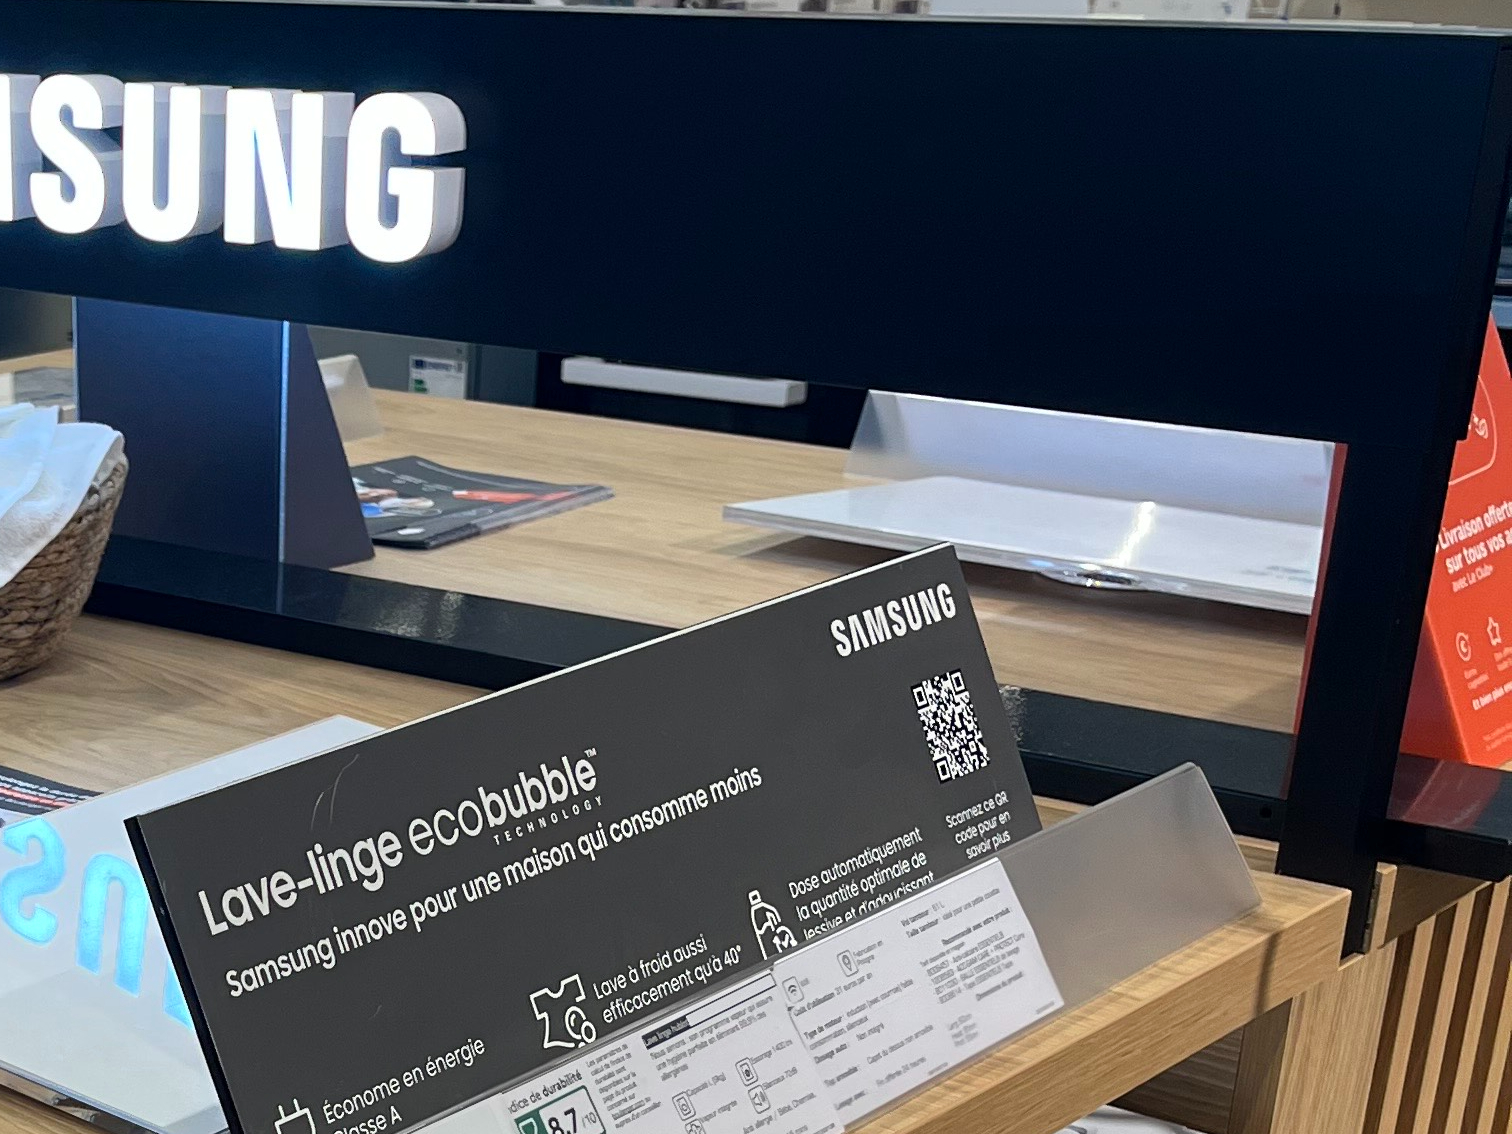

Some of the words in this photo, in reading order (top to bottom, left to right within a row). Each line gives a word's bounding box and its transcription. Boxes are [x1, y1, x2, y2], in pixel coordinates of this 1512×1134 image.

[1445, 552, 1463, 575] sur
[1462, 541, 1488, 566] tous
[830, 582, 957, 657] SAMSUNG
[493, 795, 603, 846] TECHNOLOGY
[945, 803, 985, 829] Scannez
[983, 798, 996, 812] ce
[955, 825, 979, 845] code
[977, 816, 998, 838] pour
[998, 811, 1011, 825] en
[965, 838, 992, 860] savoir
[991, 830, 1011, 851] plus
[198, 830, 403, 936] Lave-linge
[225, 937, 336, 998] Samsung
[333, 908, 408, 954] innove
[409, 886, 458, 933] pour
[461, 870, 501, 903] une
[502, 840, 577, 886] maison
[577, 821, 610, 862] qui
[609, 787, 709, 843] consomme
[709, 766, 763, 804] moins
[788, 874, 821, 899] Dose
[820, 826, 924, 885] automatiquement
[795, 905, 811, 922] la
[810, 879, 860, 919] quantité
[860, 859, 911, 895] optimale
[911, 851, 928, 869] de
[592, 973, 628, 1000] Lave
[628, 964, 641, 984] à
[639, 950, 673, 979] froid
[673, 933, 708, 964] aussi
[602, 969, 695, 1024] efficacement
[694, 954, 724, 985] qu'à
[723, 944, 742, 967] 40°
[322, 1073, 403, 1125] Économe
[402, 1066, 426, 1088] en
[426, 1037, 487, 1077] énergie
[540, 1069, 582, 1096] durabilité
[387, 1104, 403, 1126] A
